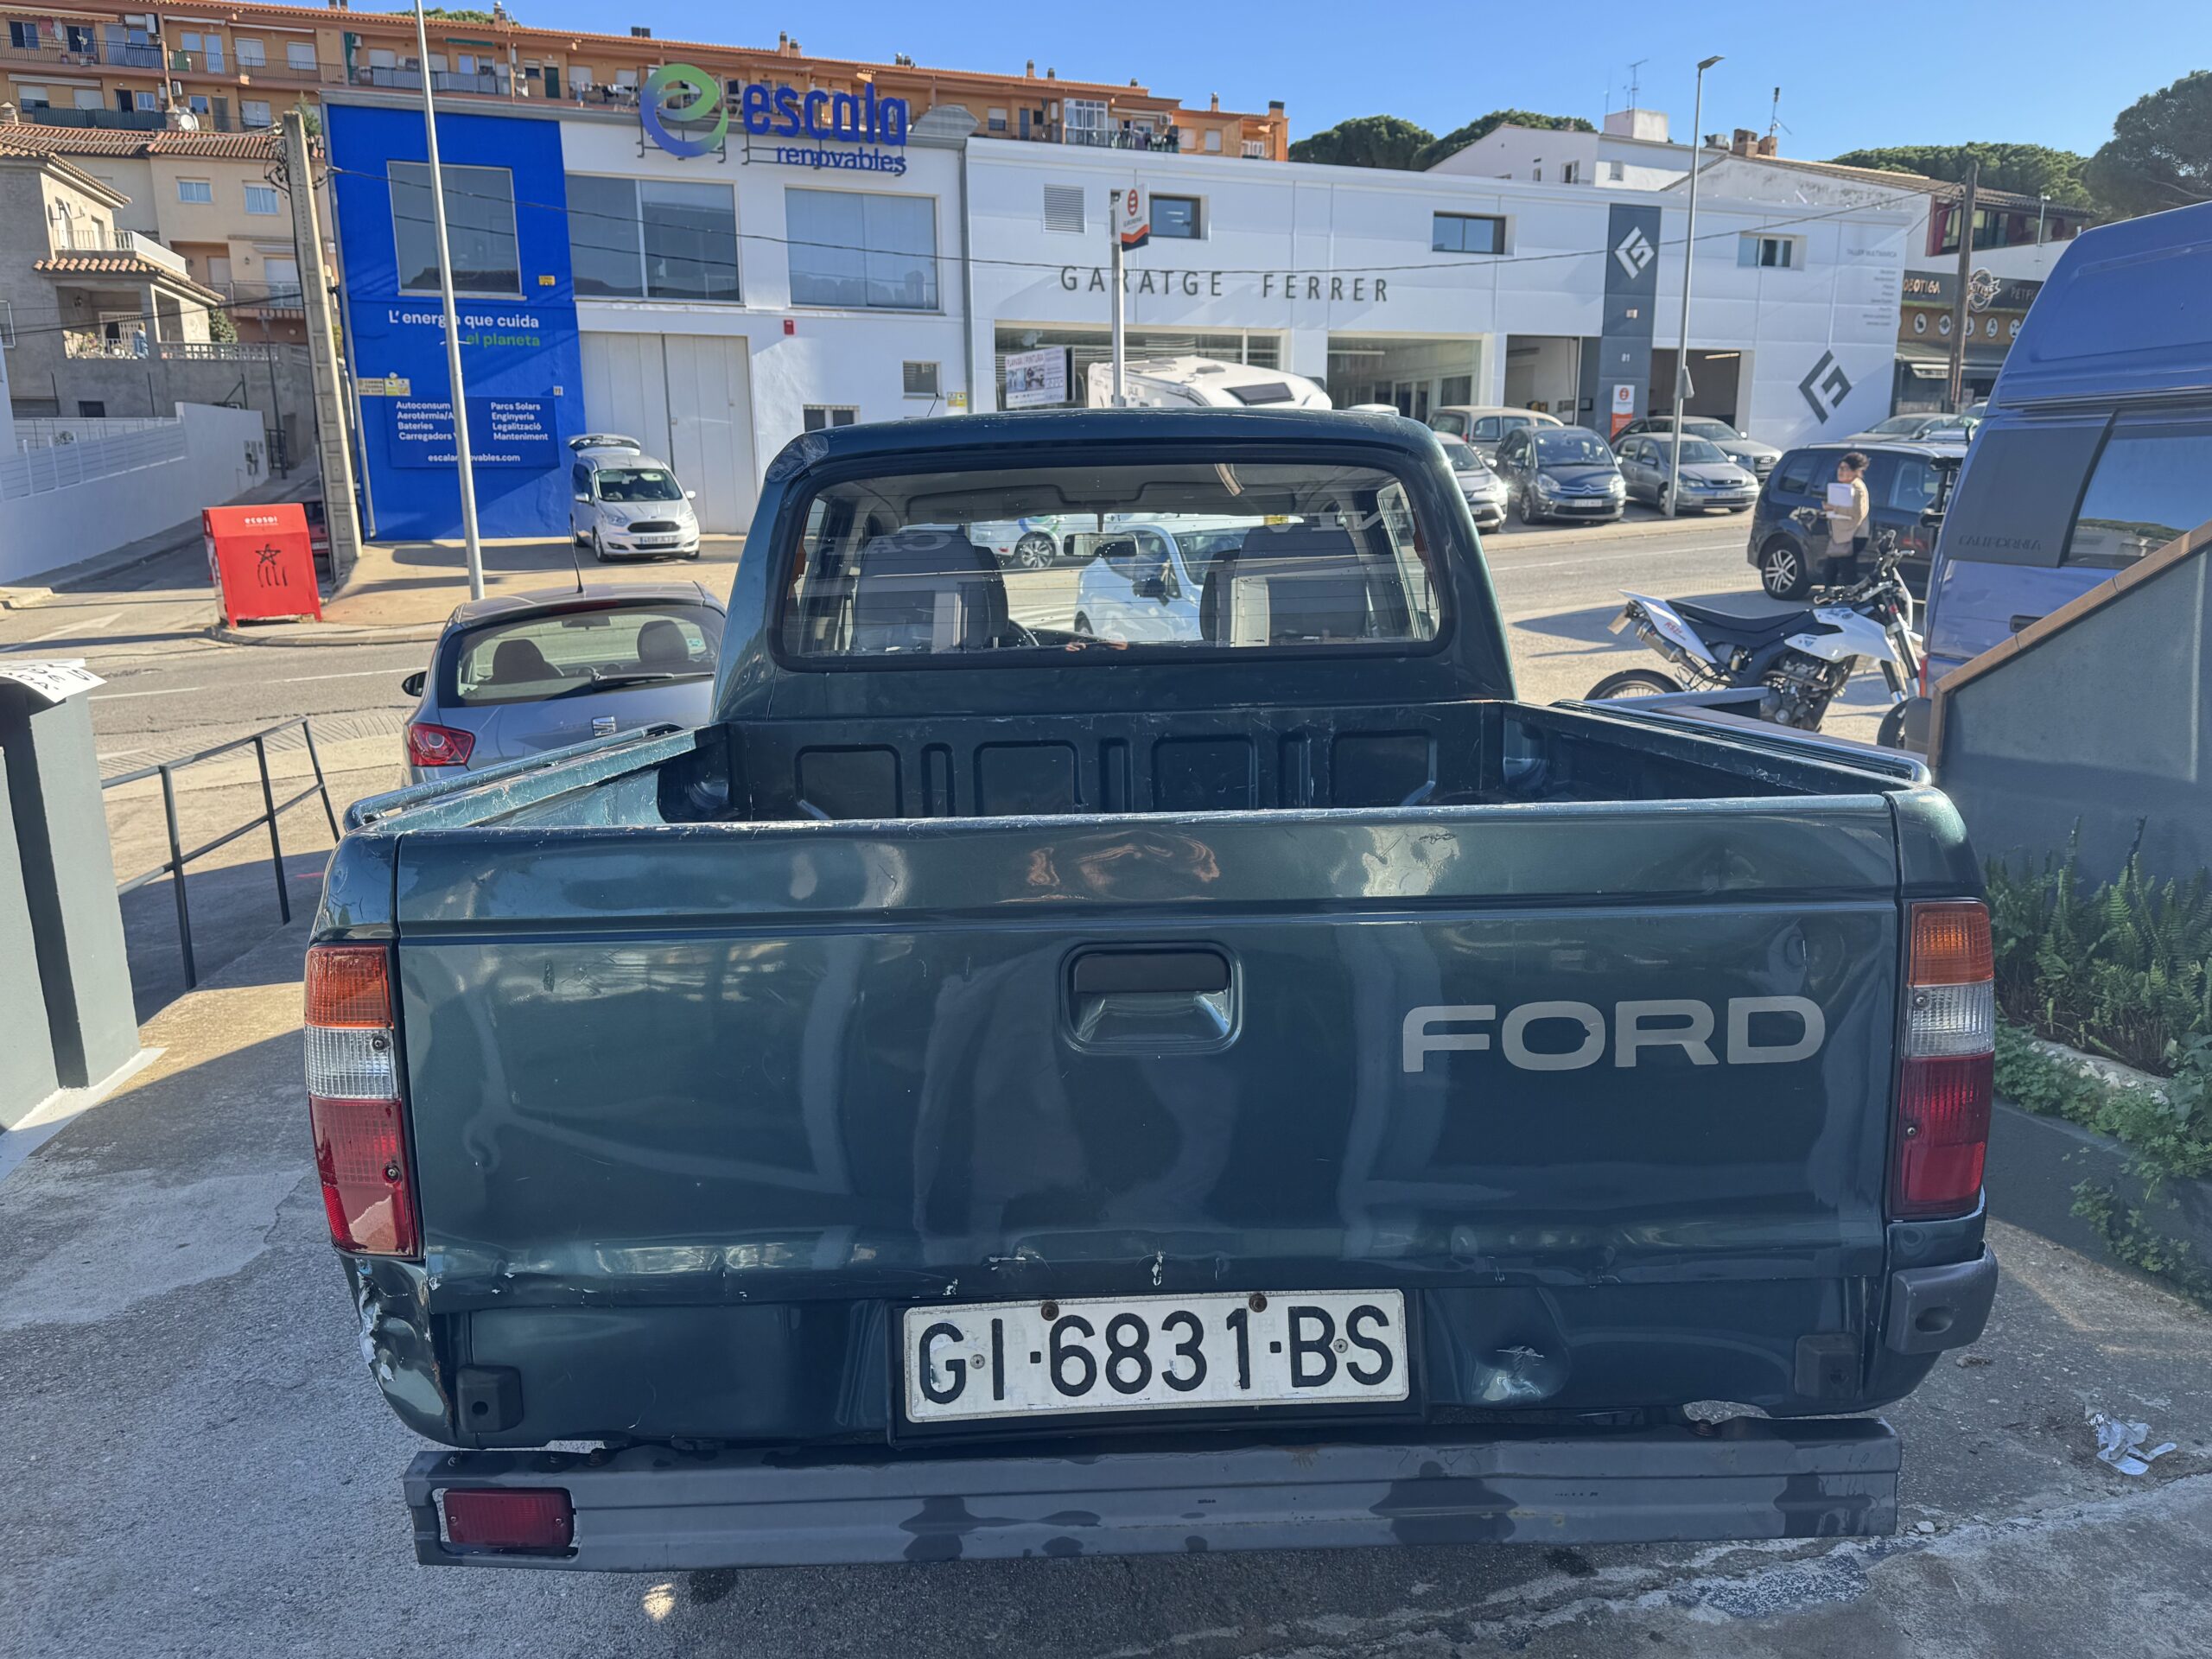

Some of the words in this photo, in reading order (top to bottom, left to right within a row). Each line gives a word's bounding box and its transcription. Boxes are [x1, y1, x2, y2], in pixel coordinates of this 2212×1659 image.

[743, 83, 906, 146] escala
[777, 145, 906, 174] renovables
[1263, 274, 1387, 302] FERRER
[402, 313, 461, 329] energa
[464, 315, 493, 329] que
[497, 314, 539, 328] cuida
[467, 332, 479, 345] el
[483, 332, 540, 348] planeta
[1621, 353, 1630, 363] 81
[396, 401, 451, 410] Autoconsum
[491, 402, 513, 410] Parcs
[515, 402, 541, 410] Solars
[397, 411, 454, 421] Aerotèrmia/A
[492, 411, 534, 423] Enginyeria
[397, 422, 434, 430] Bateries
[493, 422, 541, 432] Legalització
[399, 432, 452, 442] Carregadors
[493, 432, 549, 441] Manteniment
[428, 453, 521, 462] escalarovables.com
[1958, 534, 2042, 551] CALIFORNIA
[1402, 995, 1826, 1073] FORD
